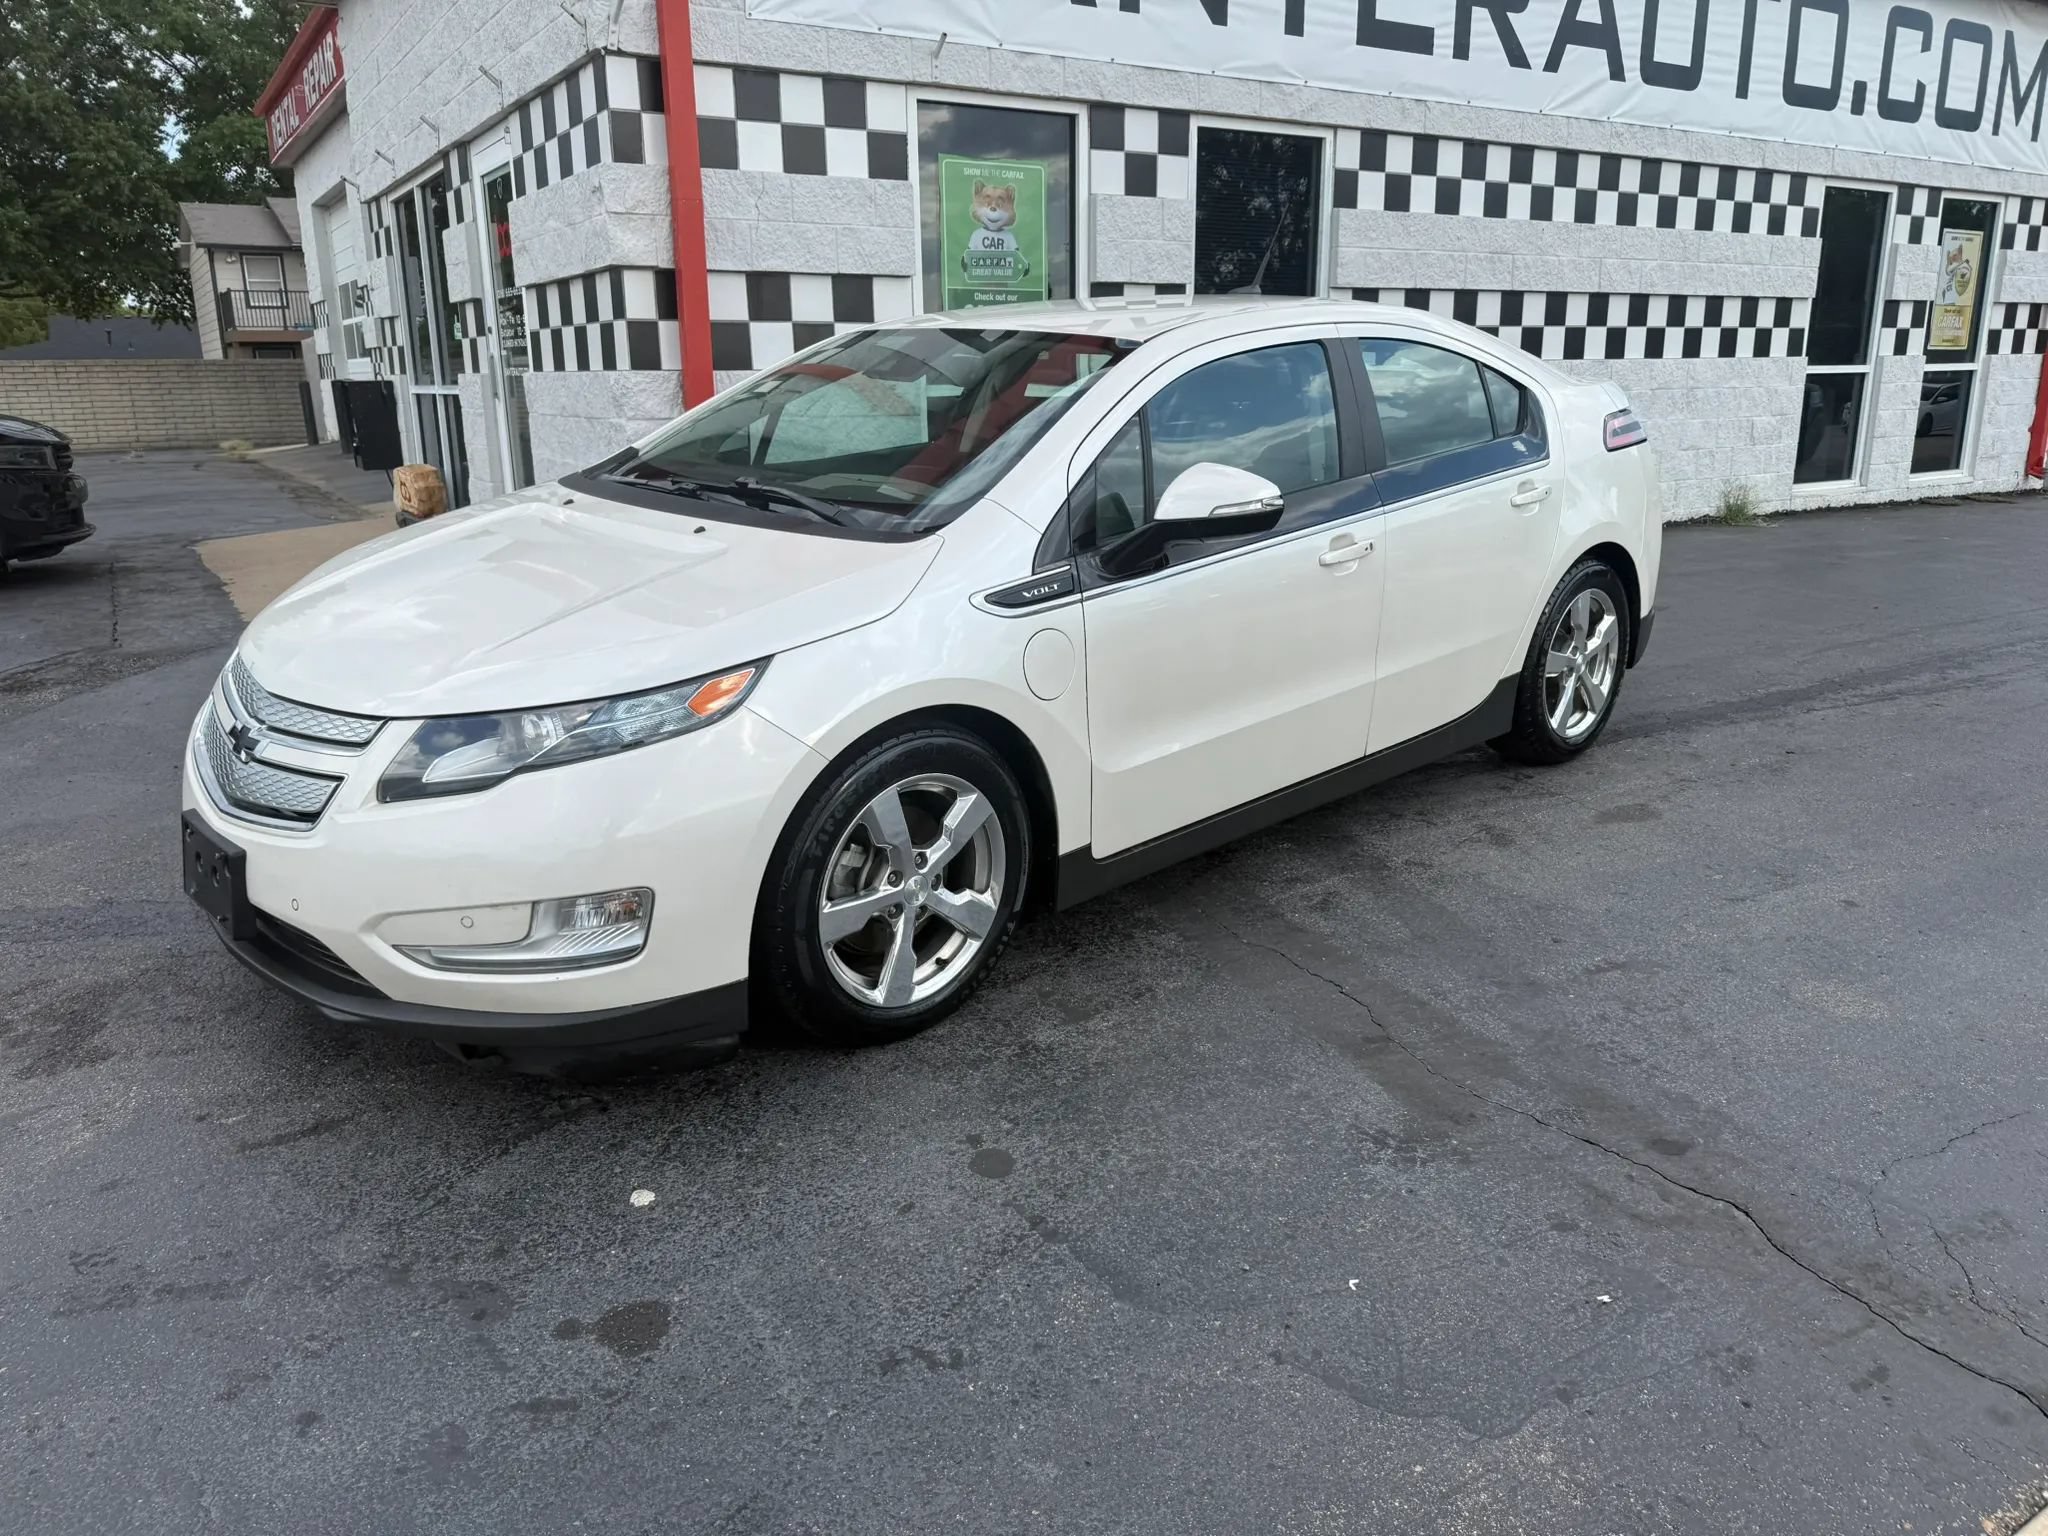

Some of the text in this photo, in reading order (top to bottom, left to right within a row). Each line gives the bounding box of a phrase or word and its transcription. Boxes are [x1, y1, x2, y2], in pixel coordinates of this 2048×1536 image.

[270, 31, 337, 152] RENTAL REPAIR
[963, 167, 981, 176] SHOW
[1002, 170, 1024, 179] CARFAX
[982, 237, 1005, 250] CAR
[971, 257, 1014, 268] CARFAX
[972, 268, 1013, 277] GREAT VALUE
[974, 292, 1018, 302] Check out our
[1022, 582, 1061, 598] VOLT
